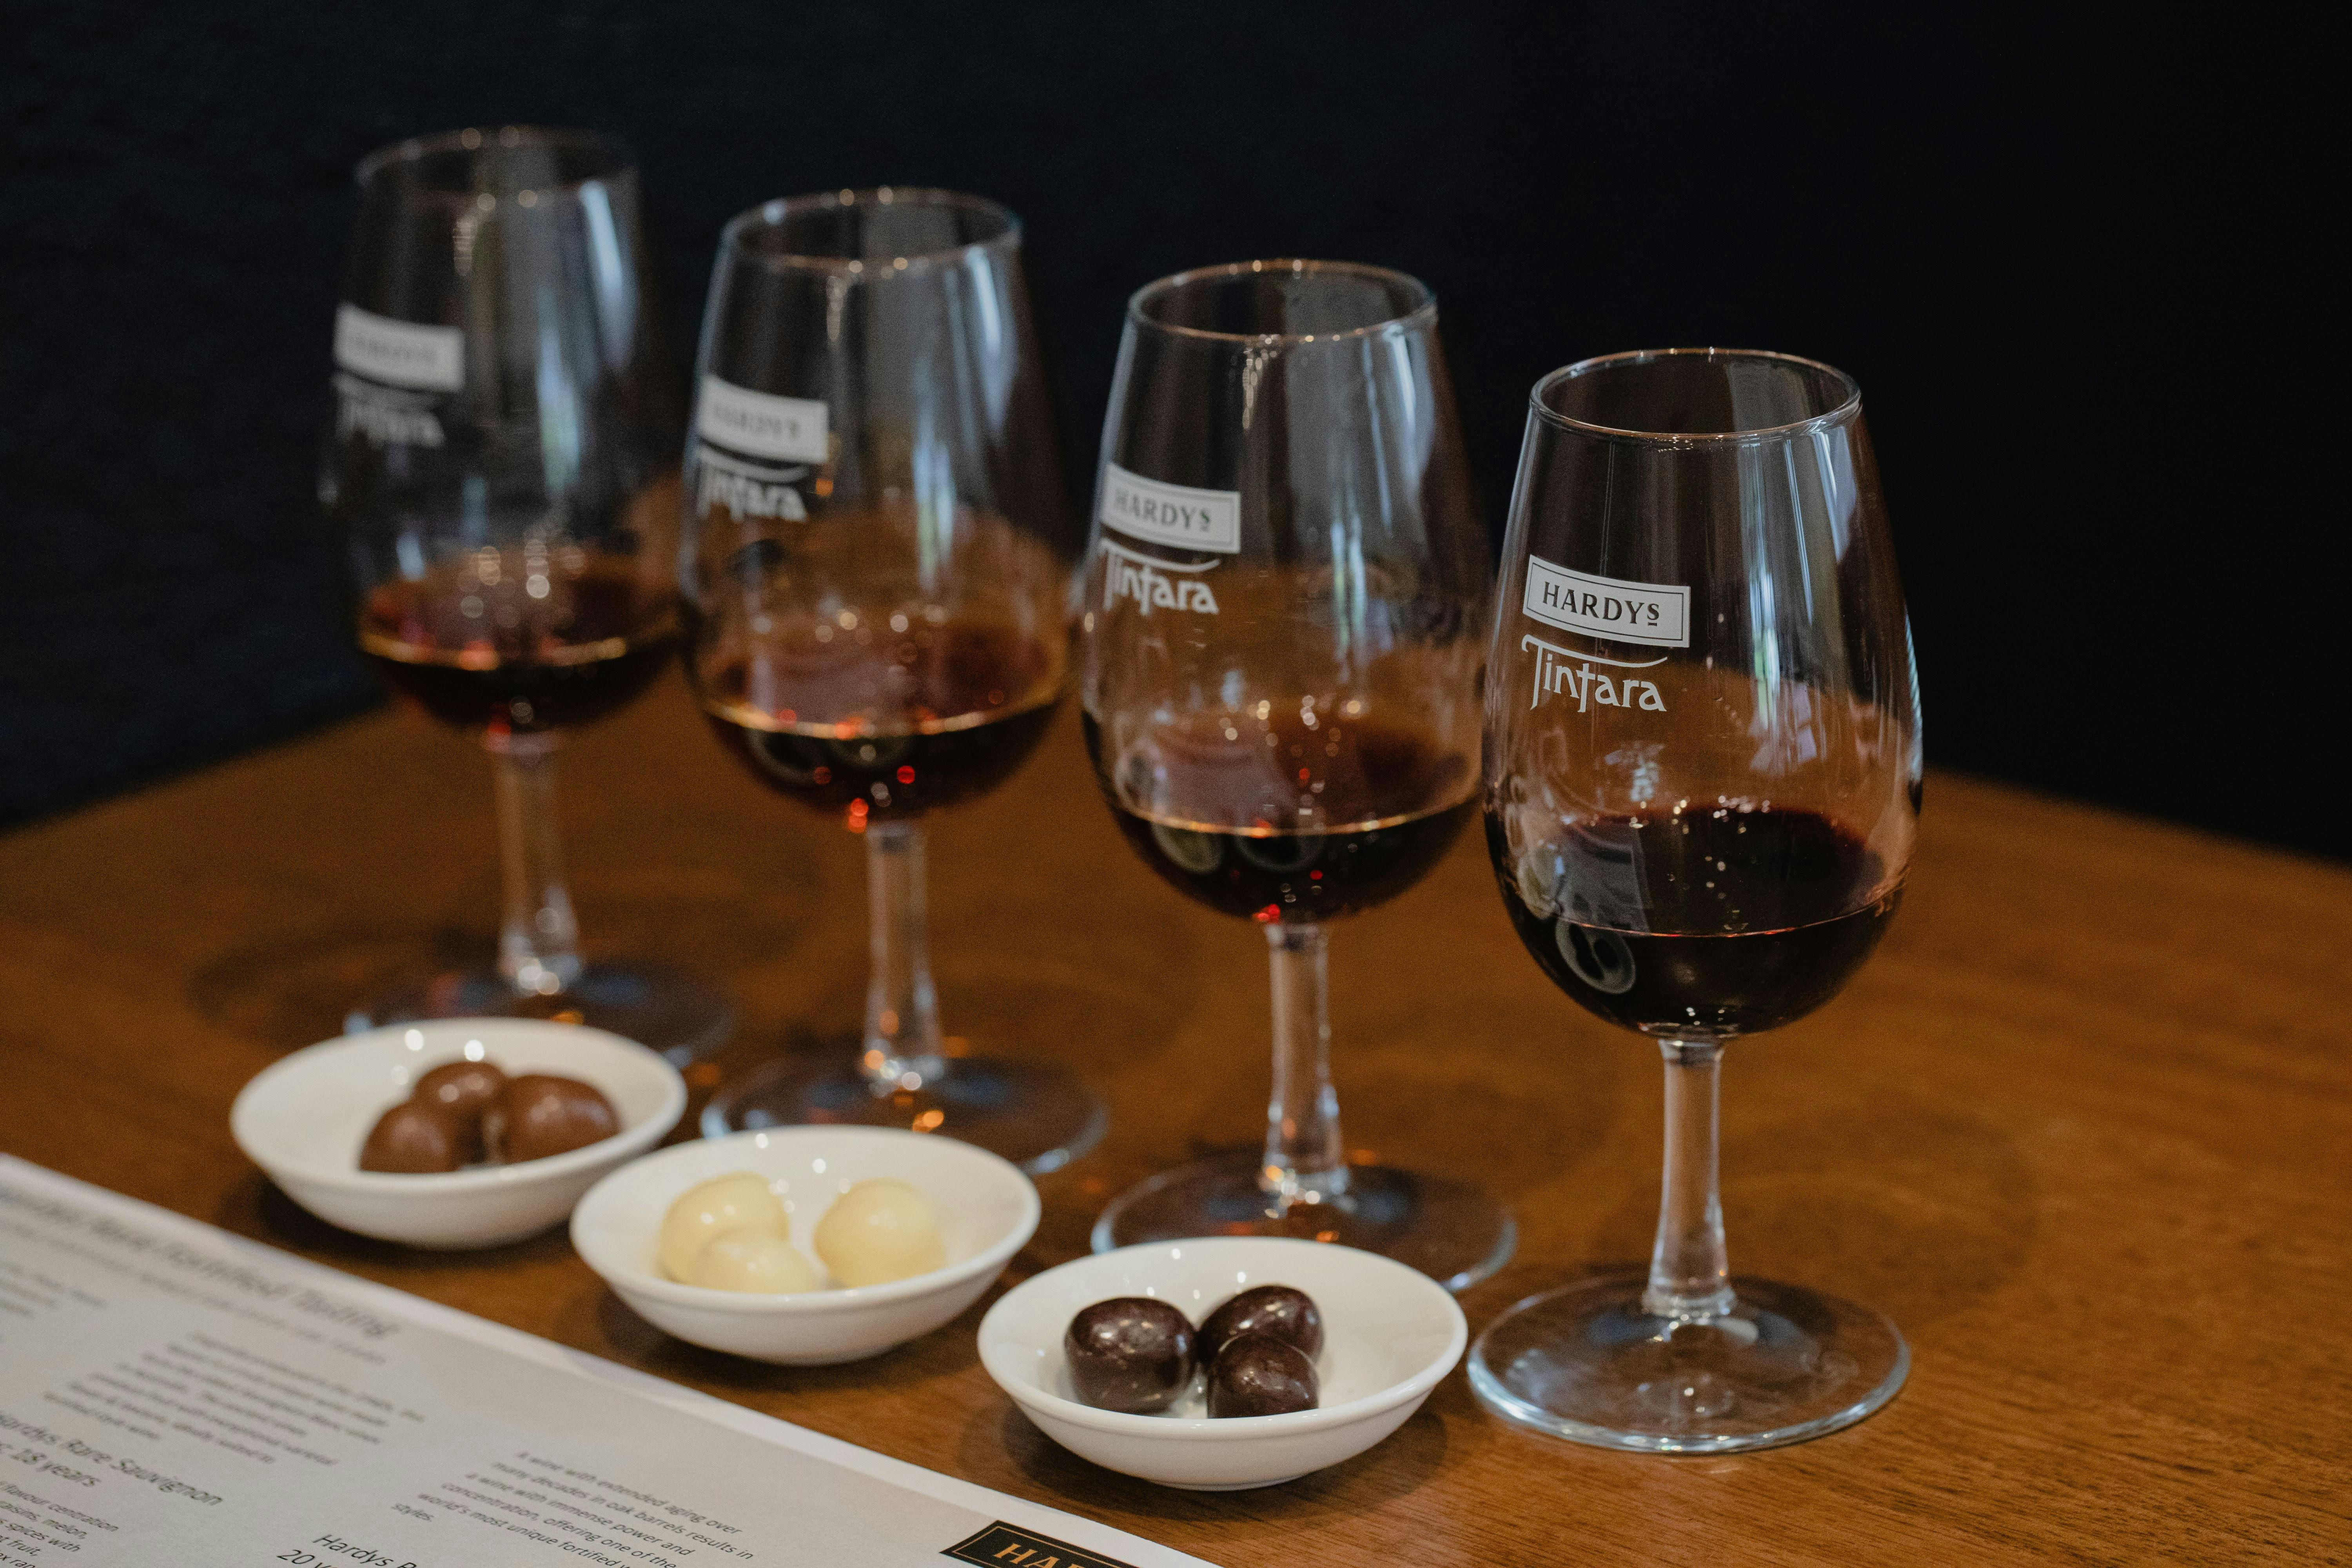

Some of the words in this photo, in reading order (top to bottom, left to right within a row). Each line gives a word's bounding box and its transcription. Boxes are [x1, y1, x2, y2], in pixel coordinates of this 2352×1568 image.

[1099, 538, 1220, 616] Tintara
[1542, 581, 1659, 626] HARDYS
[1521, 634, 1668, 713] Tintara
[35, 1461, 102, 1487] years
[109, 1457, 223, 1506] Sauvignon
[41, 1519, 87, 1539] melon,
[547, 1499, 613, 1526] immense
[610, 1523, 663, 1544] power
[660, 1541, 697, 1557] and
[589, 1495, 607, 1505] in
[605, 1501, 635, 1515] oak
[633, 1510, 687, 1535] barrels
[685, 1530, 737, 1554] results
[736, 1548, 754, 1560] in
[596, 1479, 670, 1507] extended
[664, 1504, 707, 1524] aging
[705, 1518, 742, 1535] over
[5, 1521, 49, 1540] spices
[48, 1537, 81, 1552] with
[7, 1539, 41, 1556] fruit,
[277, 1549, 315, 1565] 20
[312, 1534, 394, 1567] Hardys
[469, 1512, 508, 1527] most
[507, 1524, 558, 1545] unique
[558, 1541, 622, 1567] fortified
[543, 1516, 602, 1542] offering
[600, 1538, 632, 1552] one
[630, 1550, 655, 1559] of
[649, 1554, 677, 1568] the
